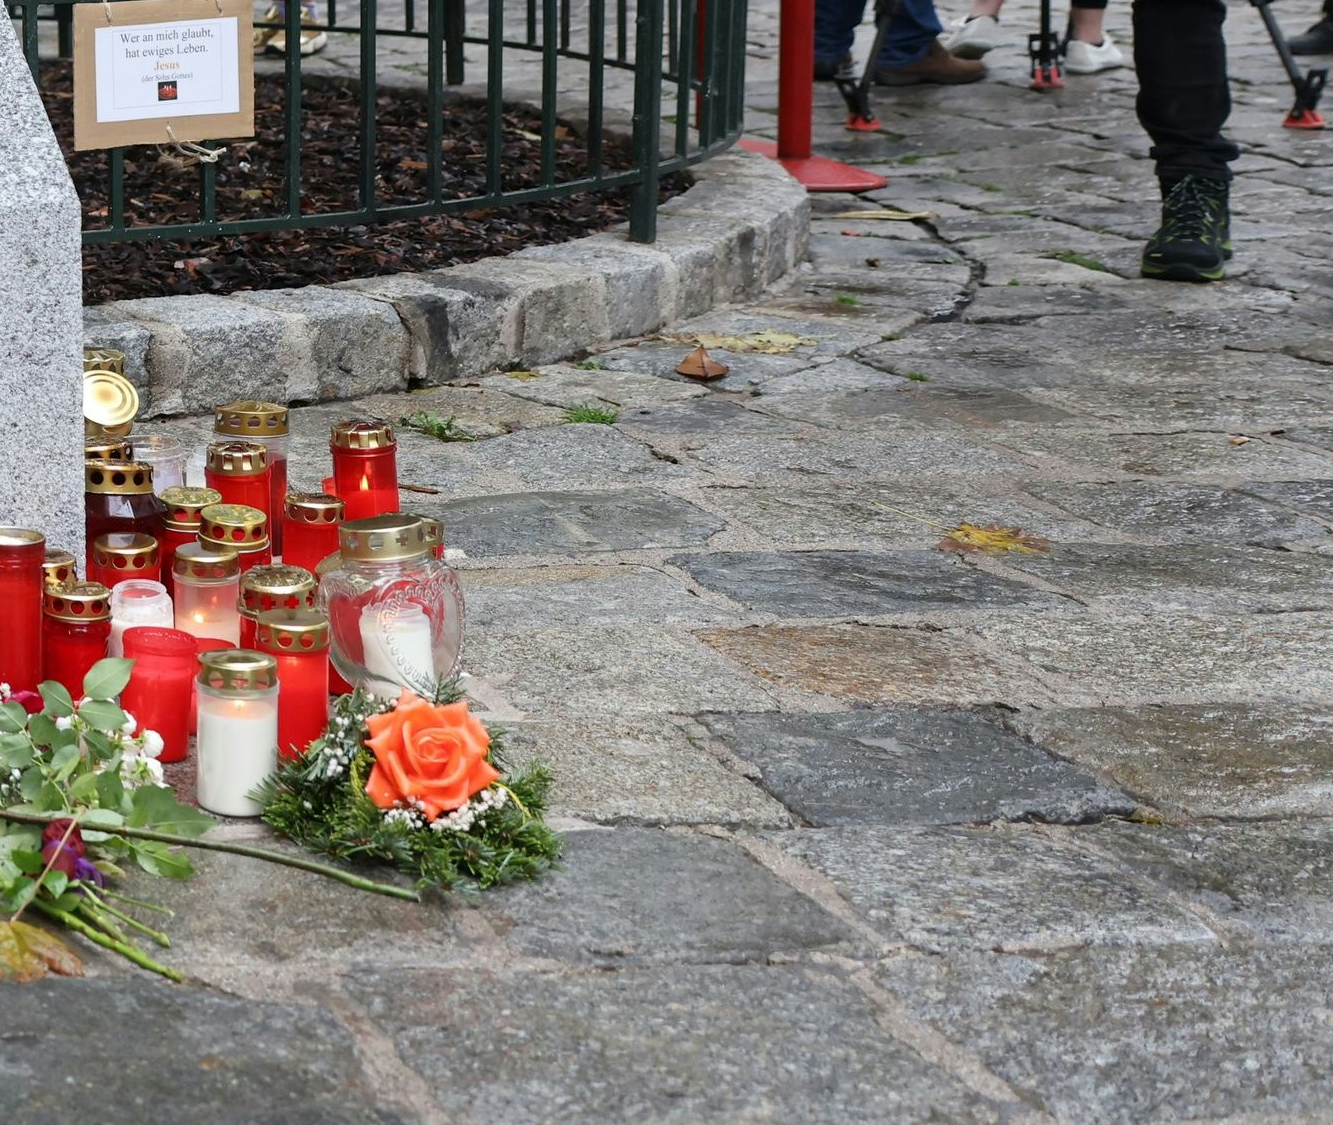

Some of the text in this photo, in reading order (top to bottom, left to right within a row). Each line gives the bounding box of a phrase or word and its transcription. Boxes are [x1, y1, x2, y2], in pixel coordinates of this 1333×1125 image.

[120, 28, 213, 43] Wer an mich glaubt,
[125, 43, 208, 58] hat ewiges Leben.
[154, 61, 180, 71] Jesus
